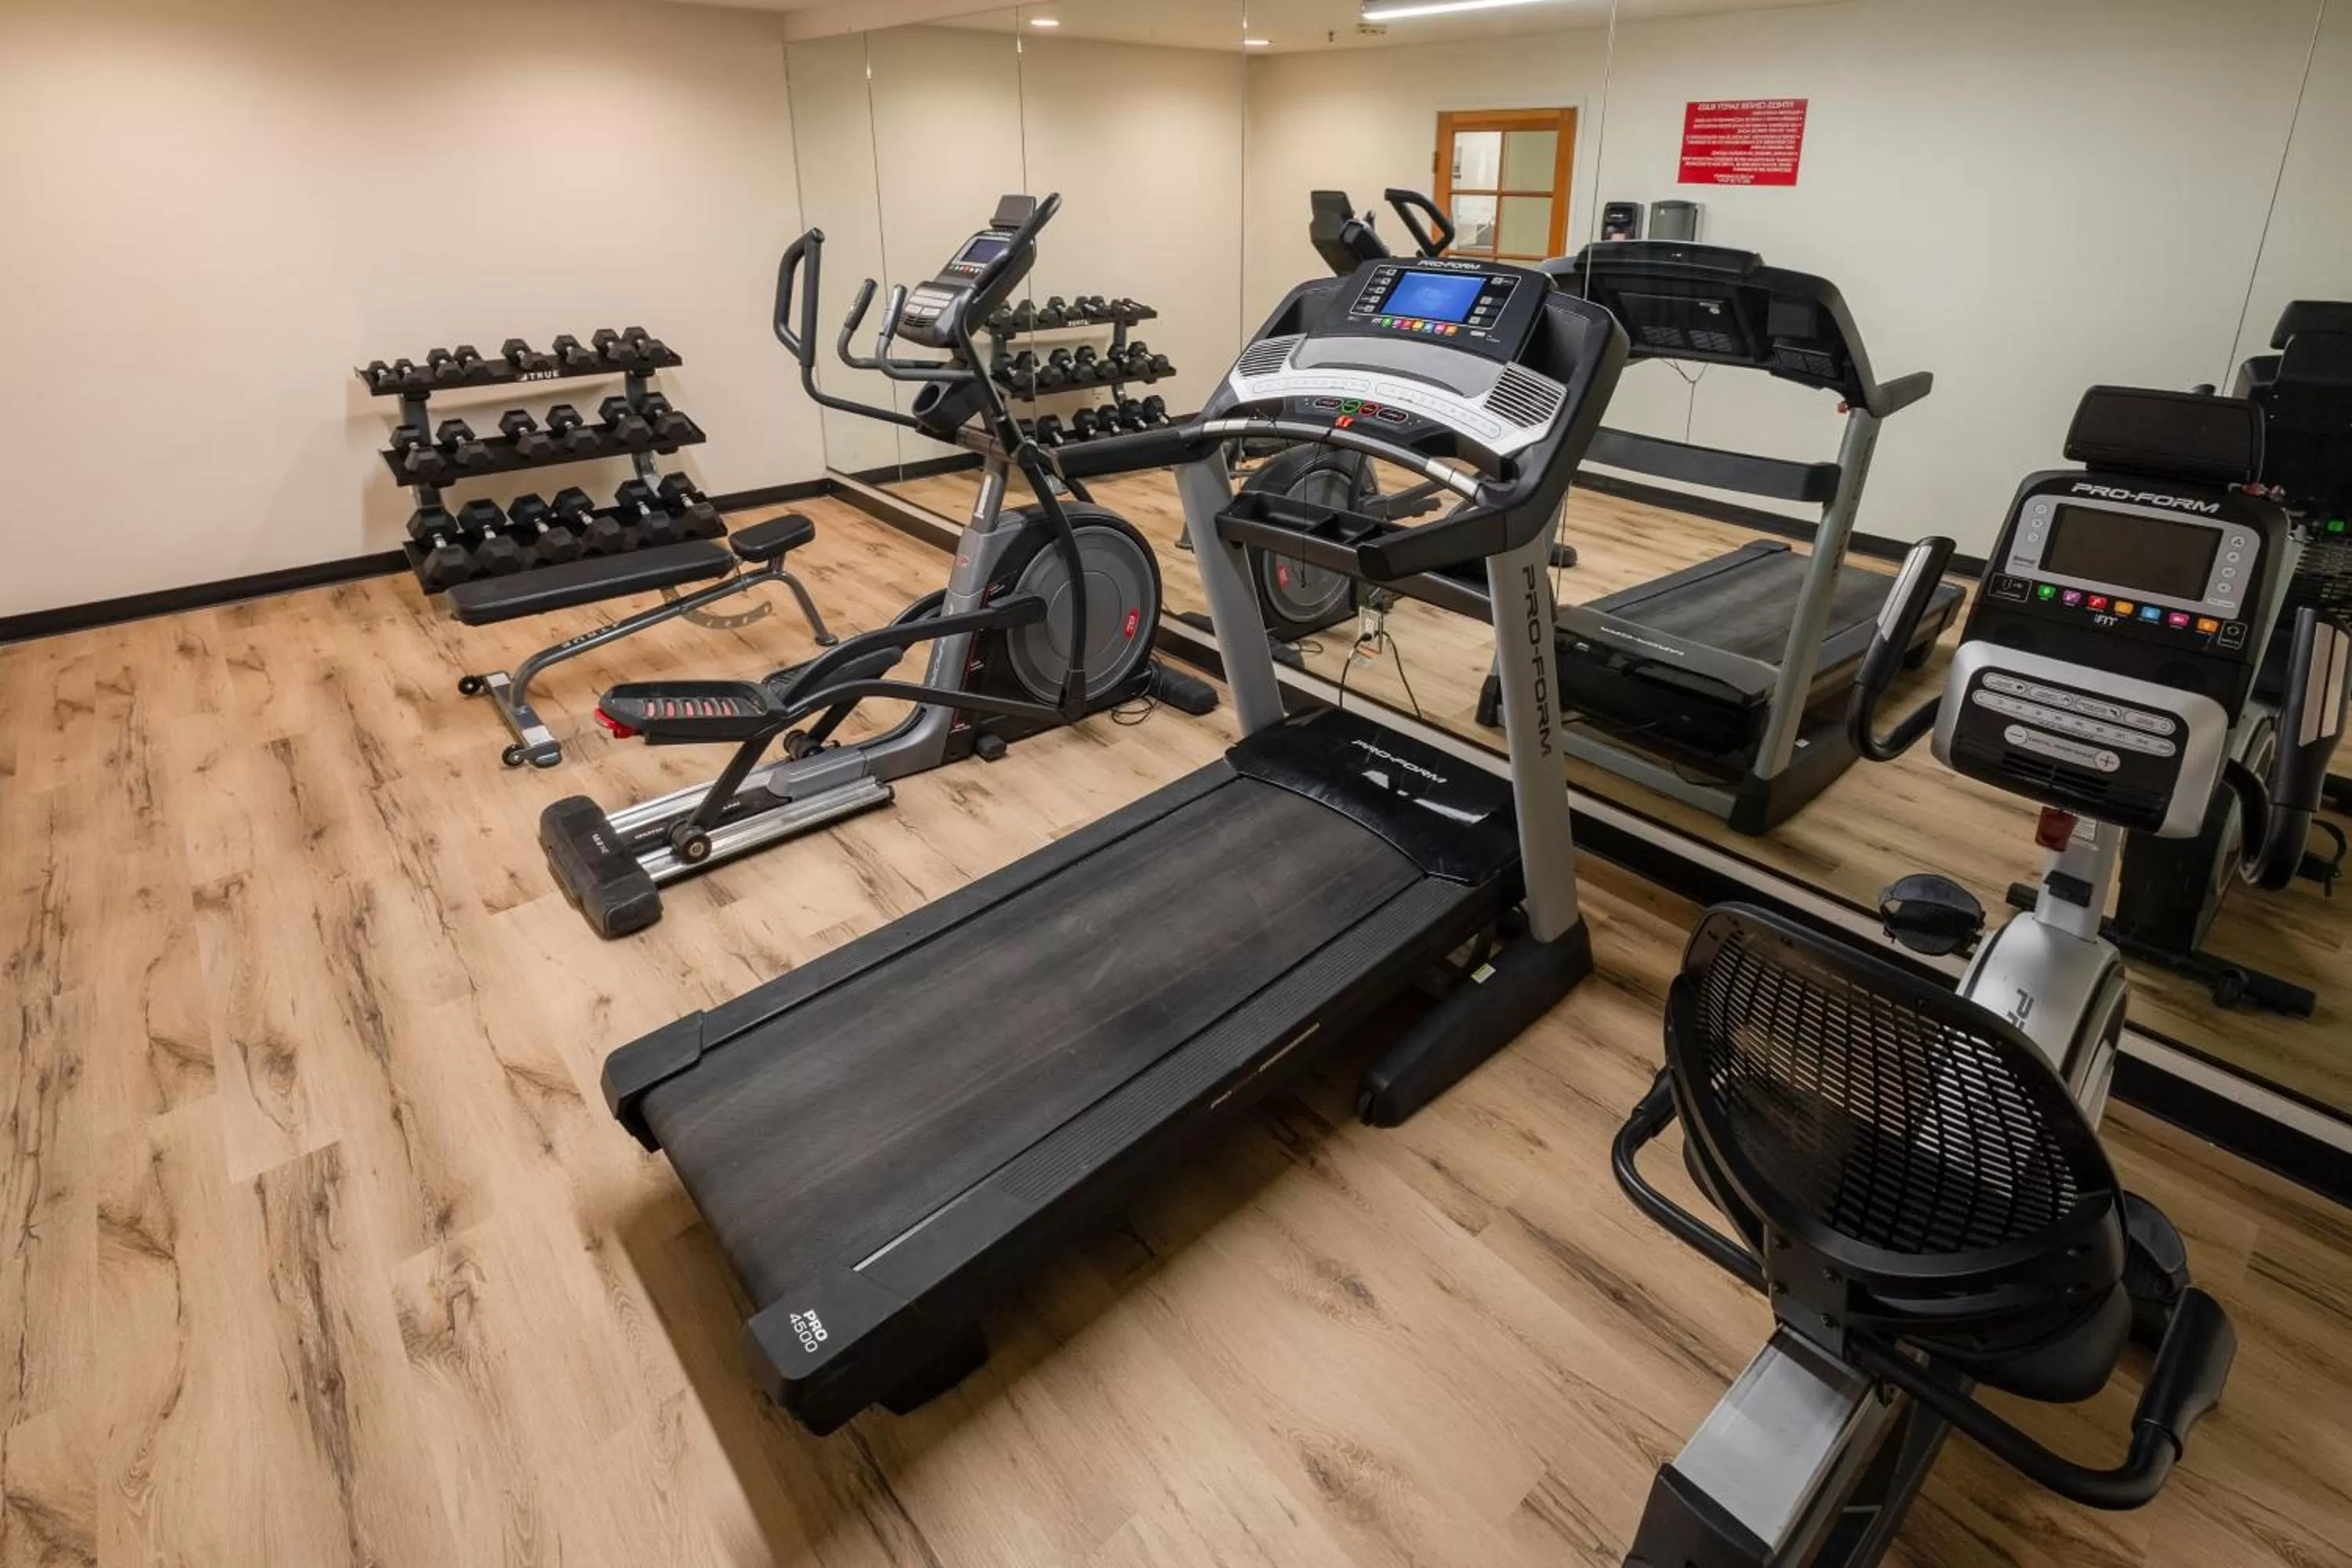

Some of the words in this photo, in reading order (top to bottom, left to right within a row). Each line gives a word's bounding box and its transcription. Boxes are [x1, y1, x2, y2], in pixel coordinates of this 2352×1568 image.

[2071, 482, 2220, 514] PRO-FORM
[1522, 564, 1552, 759] PRO-FORM
[1351, 740, 1448, 783] PRO-FORM
[789, 1312, 818, 1353] 4500
[803, 1308, 829, 1341] PRO
